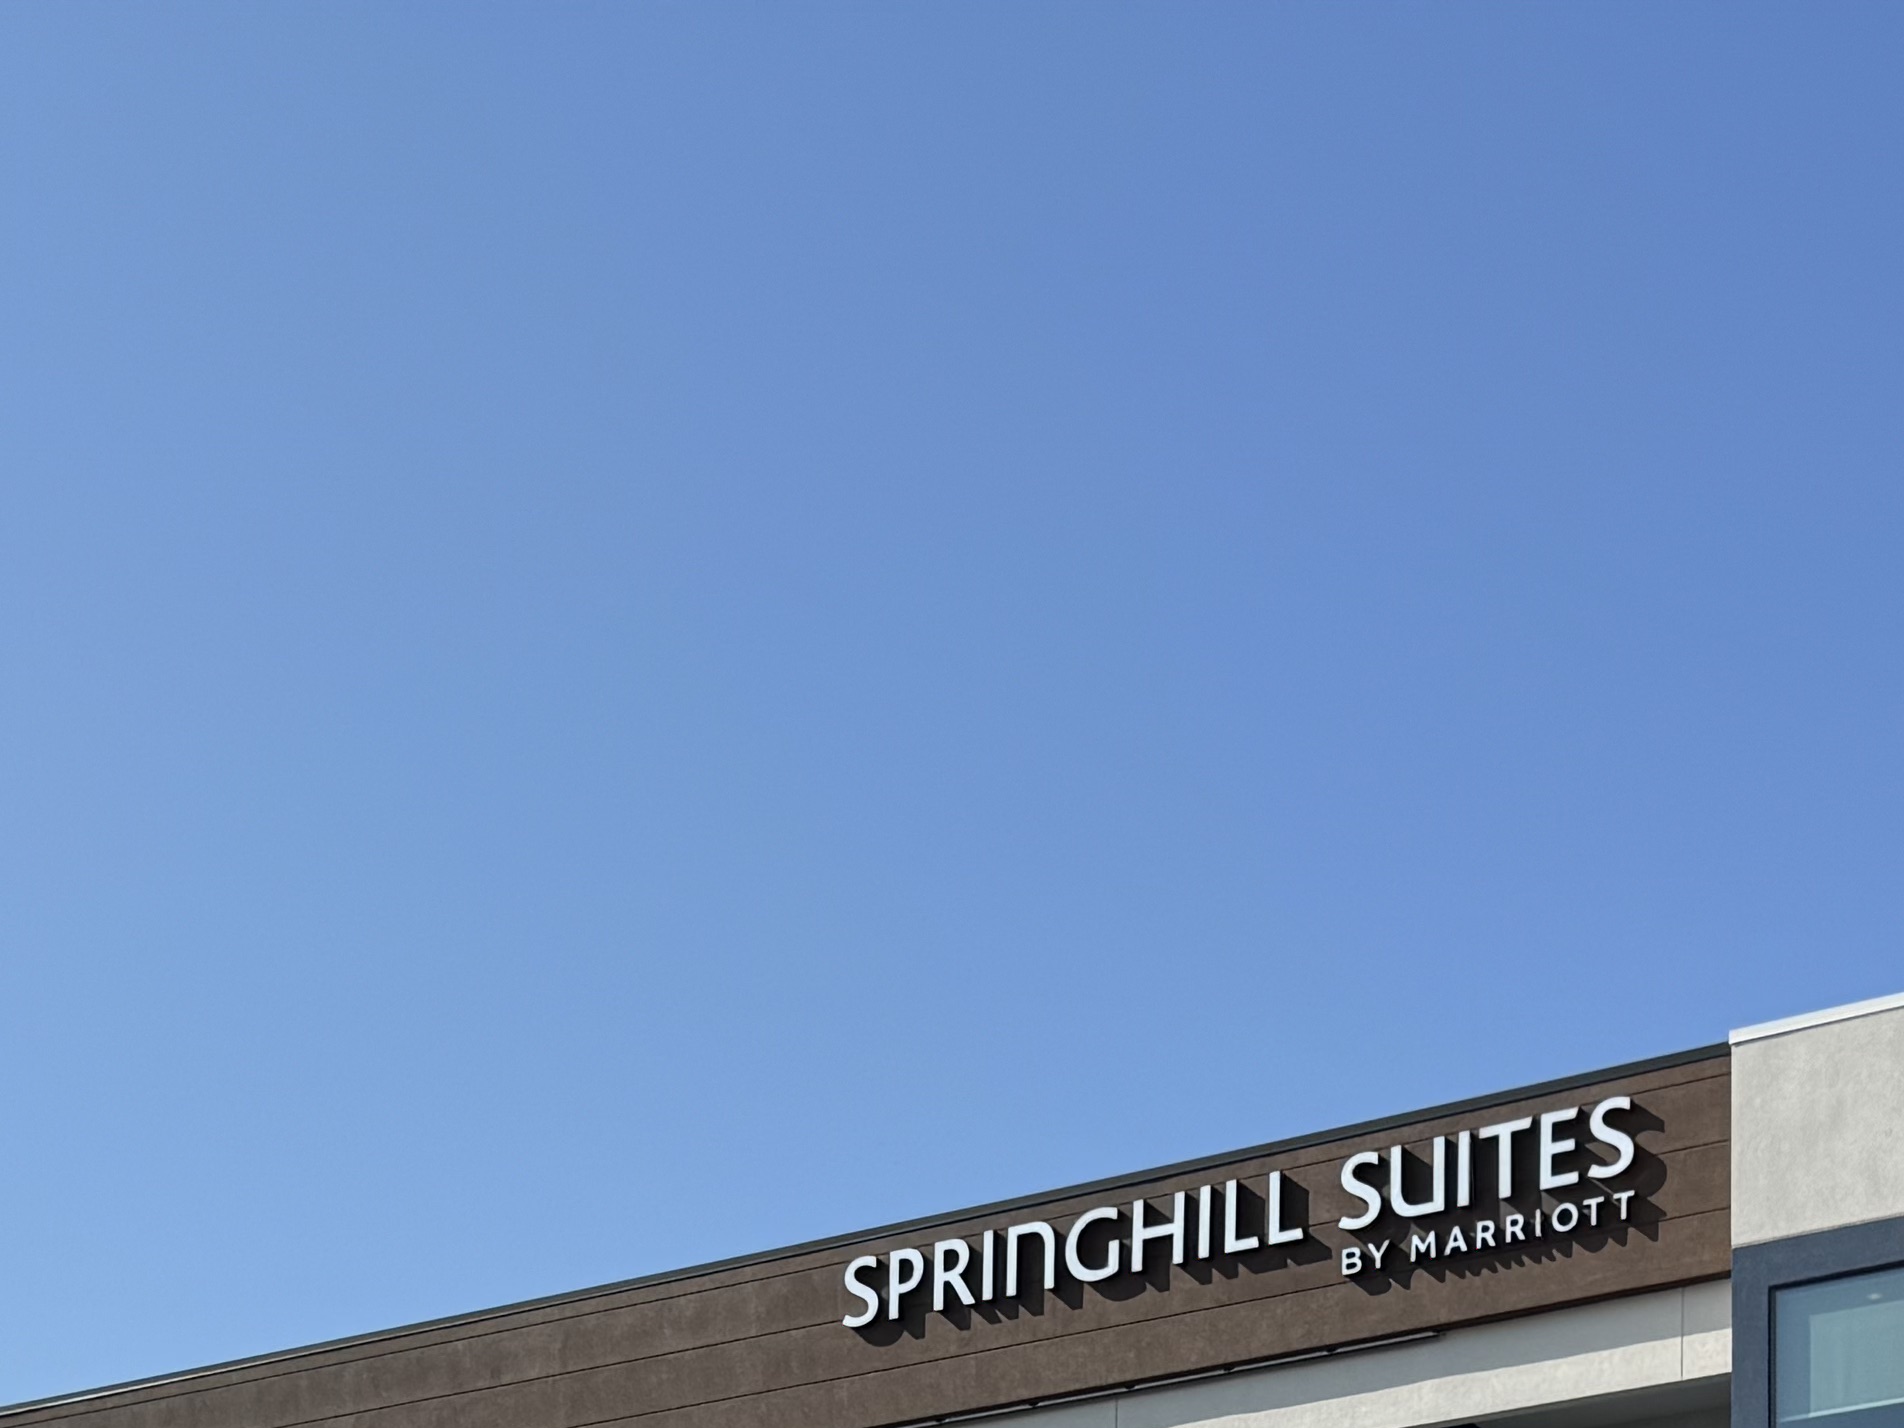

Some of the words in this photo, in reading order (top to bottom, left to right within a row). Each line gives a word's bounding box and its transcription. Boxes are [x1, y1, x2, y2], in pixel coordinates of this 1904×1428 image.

[842, 1170, 1304, 1328] SPRINGHILL
[1337, 1095, 1635, 1231] SUITES
[1340, 1240, 1390, 1277] BY
[1409, 1190, 1636, 1263] MARRIOTT
